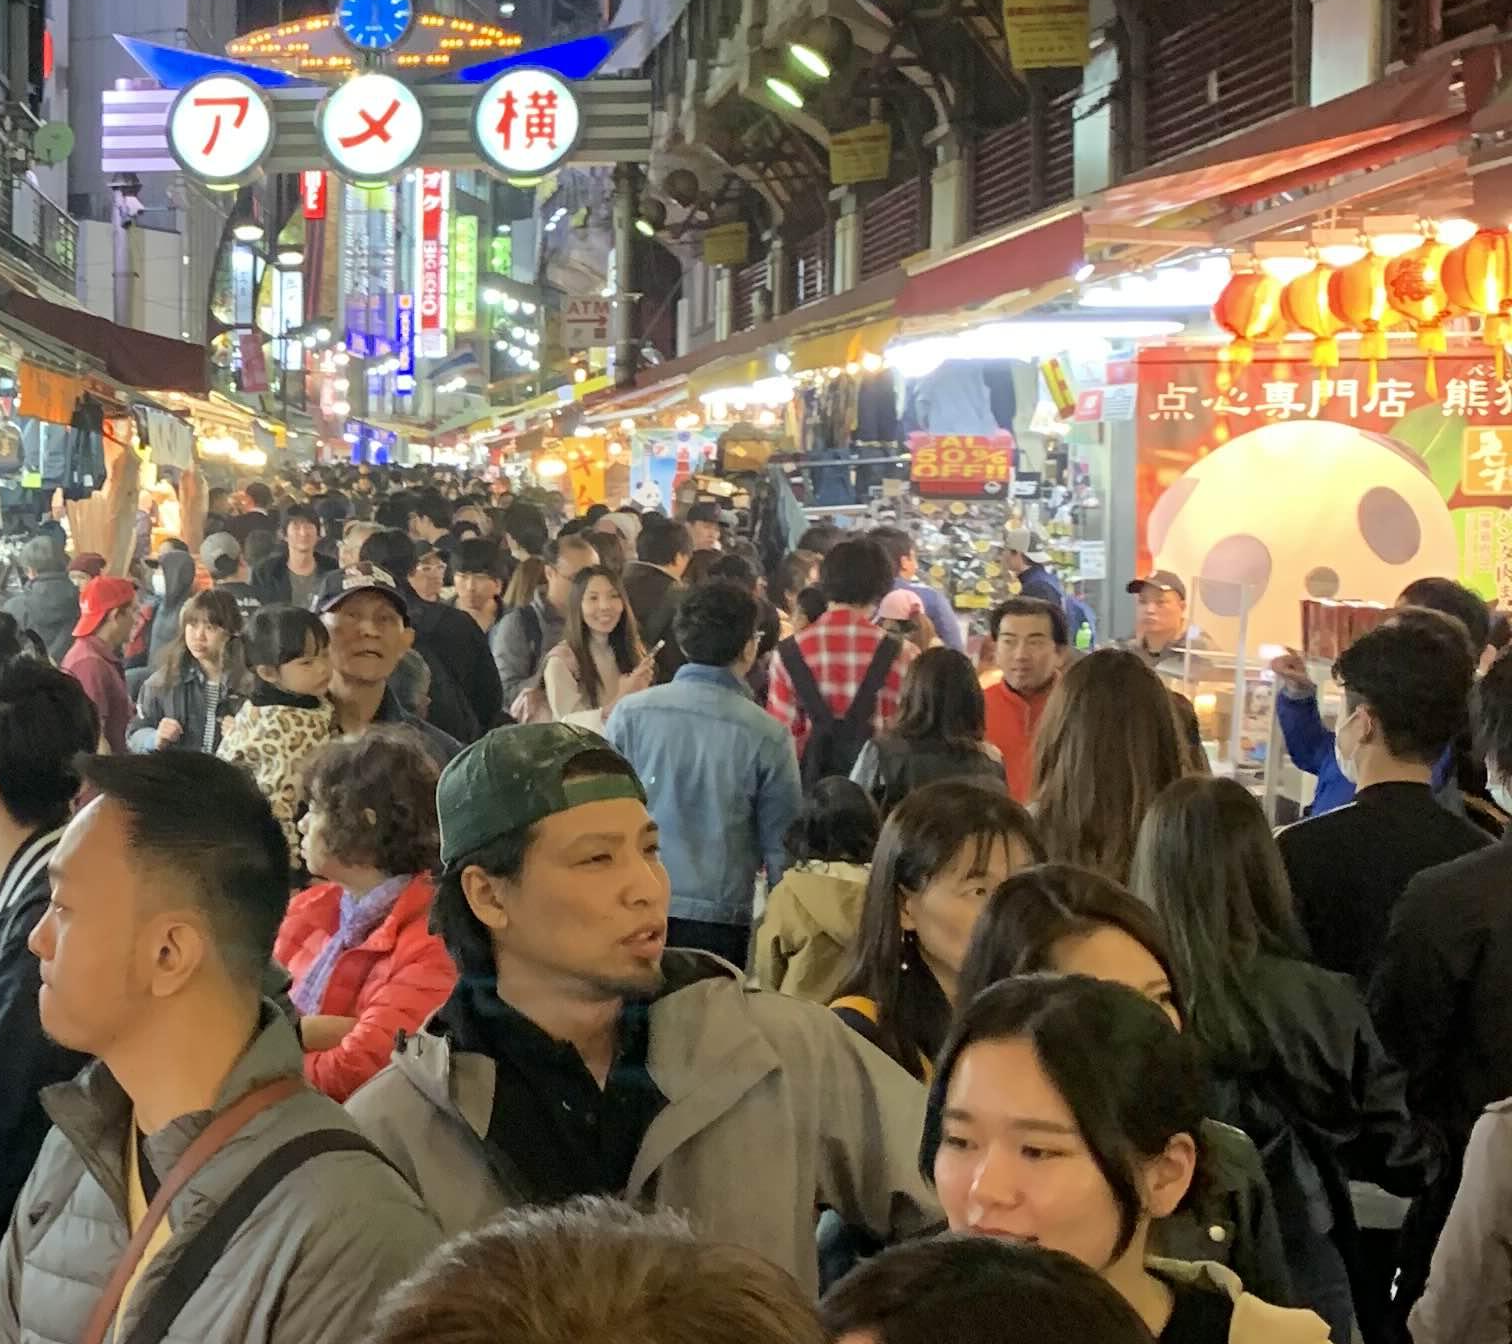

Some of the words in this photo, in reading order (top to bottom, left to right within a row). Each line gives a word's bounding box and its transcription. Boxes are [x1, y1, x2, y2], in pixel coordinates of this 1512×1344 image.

[193, 88, 559, 156] アメ横
[423, 240, 438, 269] BIG
[423, 273, 438, 316] ECHO
[569, 301, 609, 314] ATM
[1148, 377, 1415, 420] 点心専門店
[916, 448, 1008, 464] 50%
[912, 464, 1007, 479] OFF!!
